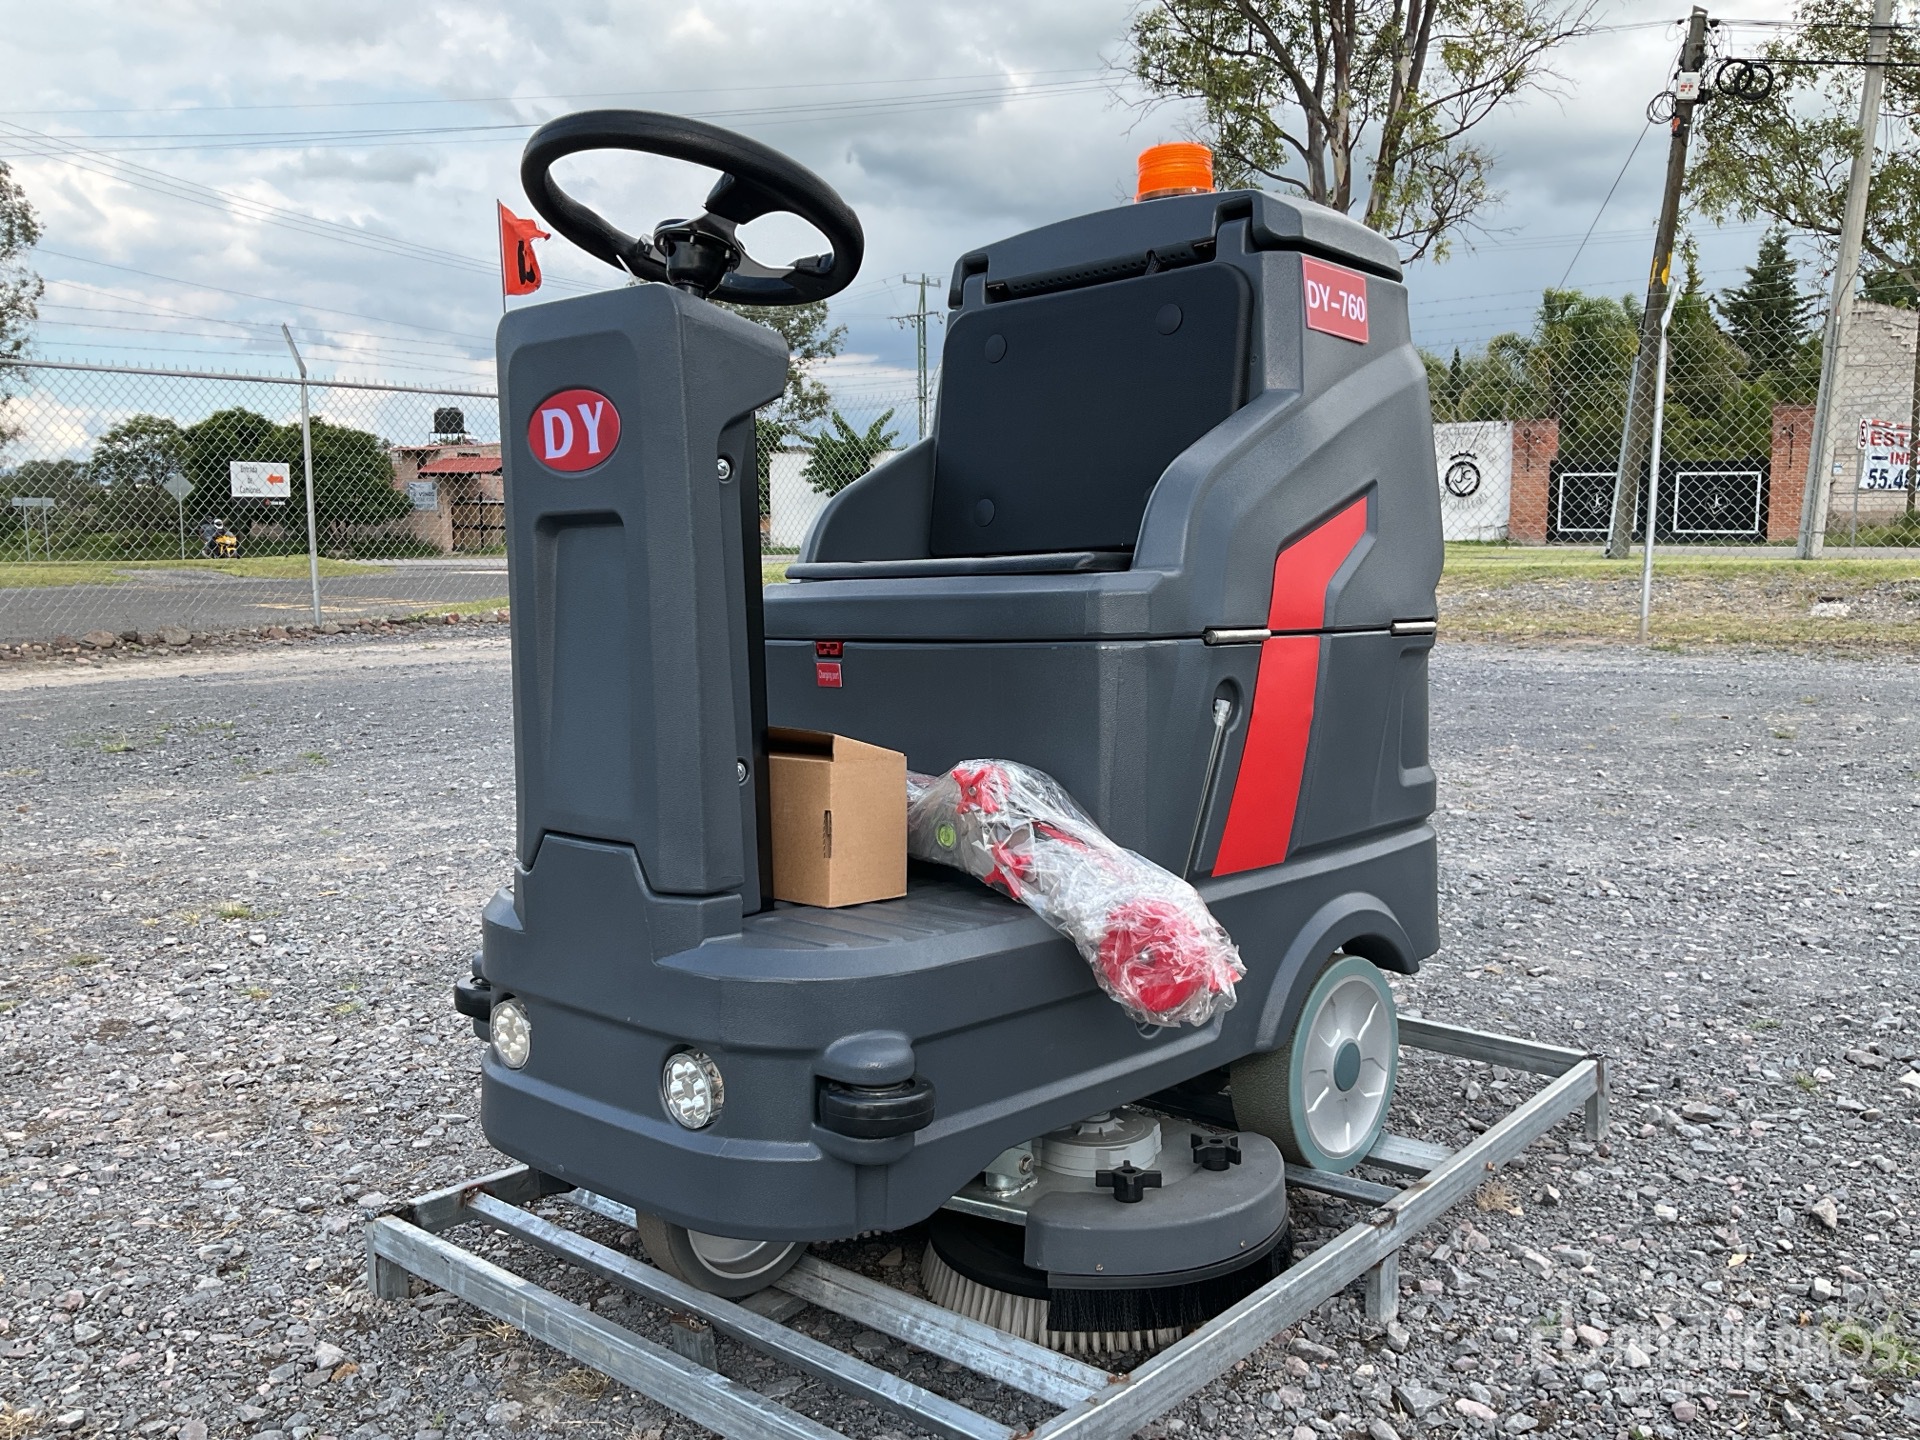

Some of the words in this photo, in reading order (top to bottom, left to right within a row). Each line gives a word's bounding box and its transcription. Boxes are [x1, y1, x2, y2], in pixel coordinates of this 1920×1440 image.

[1307, 279, 1366, 323] DY-760
[541, 401, 604, 460] DY
[1870, 431, 1920, 447] EST
[240, 465, 258, 473] Entrada
[239, 486, 262, 494] Camiones
